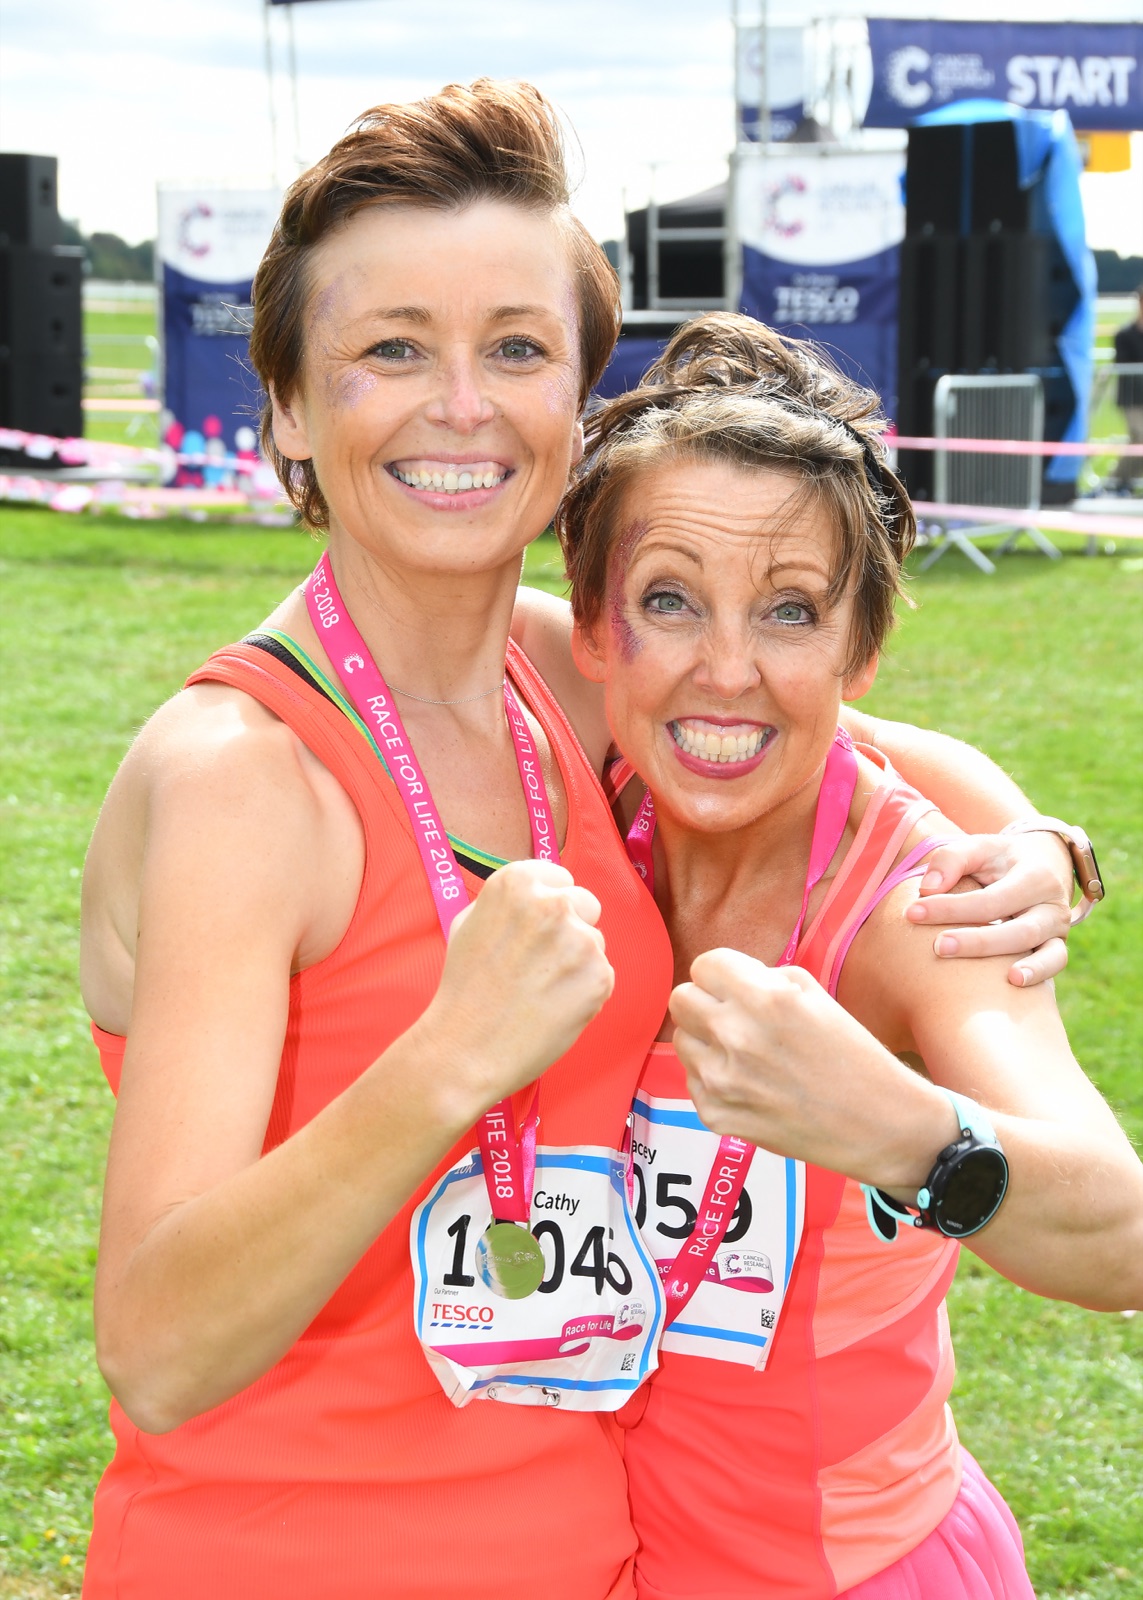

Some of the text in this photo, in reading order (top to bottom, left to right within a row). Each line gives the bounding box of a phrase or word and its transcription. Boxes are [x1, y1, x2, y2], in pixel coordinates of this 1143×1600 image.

[1006, 55, 1137, 107] START
[314, 587, 340, 629] 2018
[513, 717, 533, 754] LIFE
[366, 694, 460, 901] RACE FOR LIFE 2018
[523, 760, 543, 801] FOR
[533, 807, 552, 863] RACE
[489, 1149, 514, 1199] 2018
[533, 1191, 581, 1216] Cathy
[688, 1210, 724, 1257] RACE
[710, 1165, 739, 1206] FOR
[442, 1213, 633, 1296] 1046
[431, 1303, 495, 1323] TESCO
[565, 1319, 612, 1338] Race for Life
